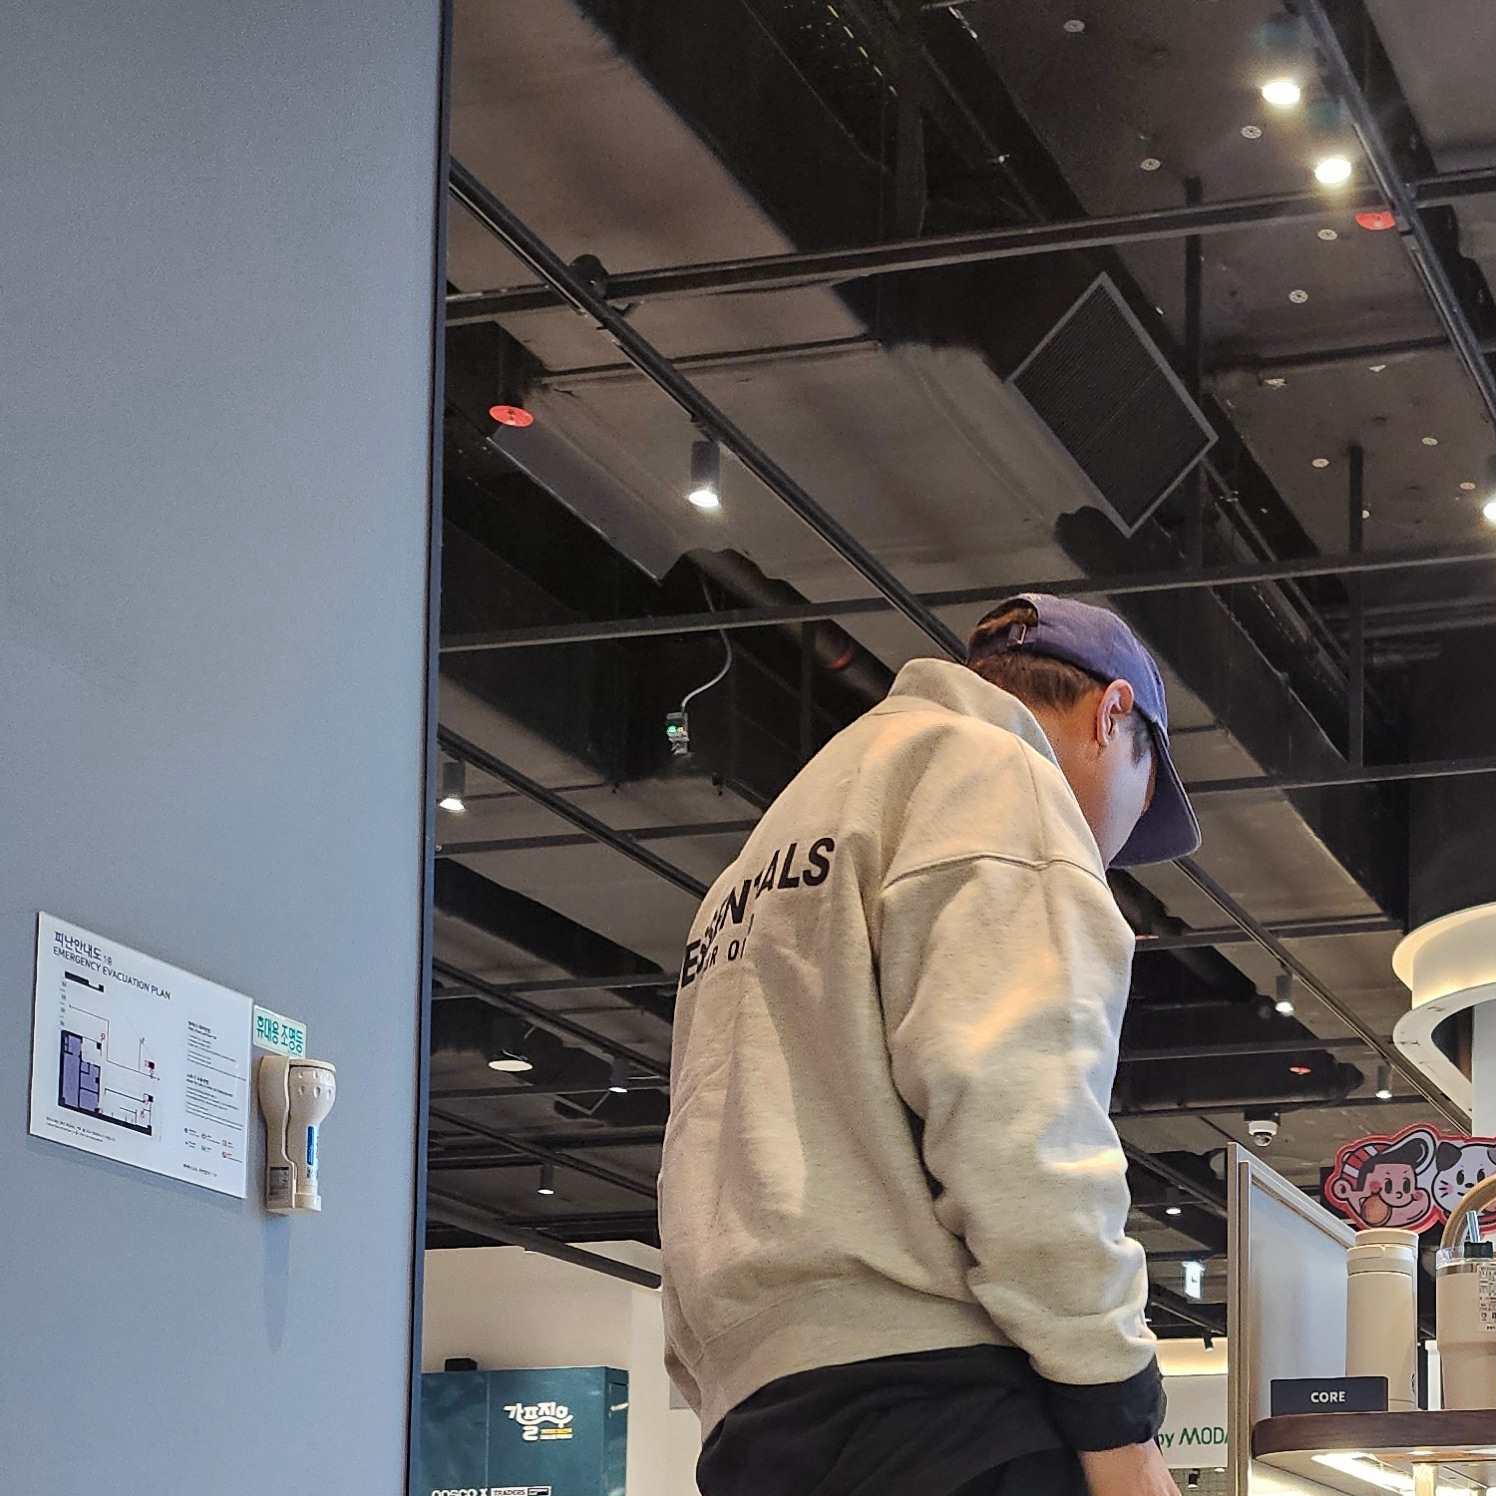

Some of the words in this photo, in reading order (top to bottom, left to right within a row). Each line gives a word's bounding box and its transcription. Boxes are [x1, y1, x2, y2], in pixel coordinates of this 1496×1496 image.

[54, 931, 103, 961] 피난안내도
[53, 946, 101, 972] EMERGENCY
[102, 966, 150, 991] EVACUATION
[151, 985, 171, 1000] PLAN
[256, 1015, 280, 1045] 휴대용
[280, 1023, 304, 1054] 조명등
[1310, 1391, 1346, 1403] CORE
